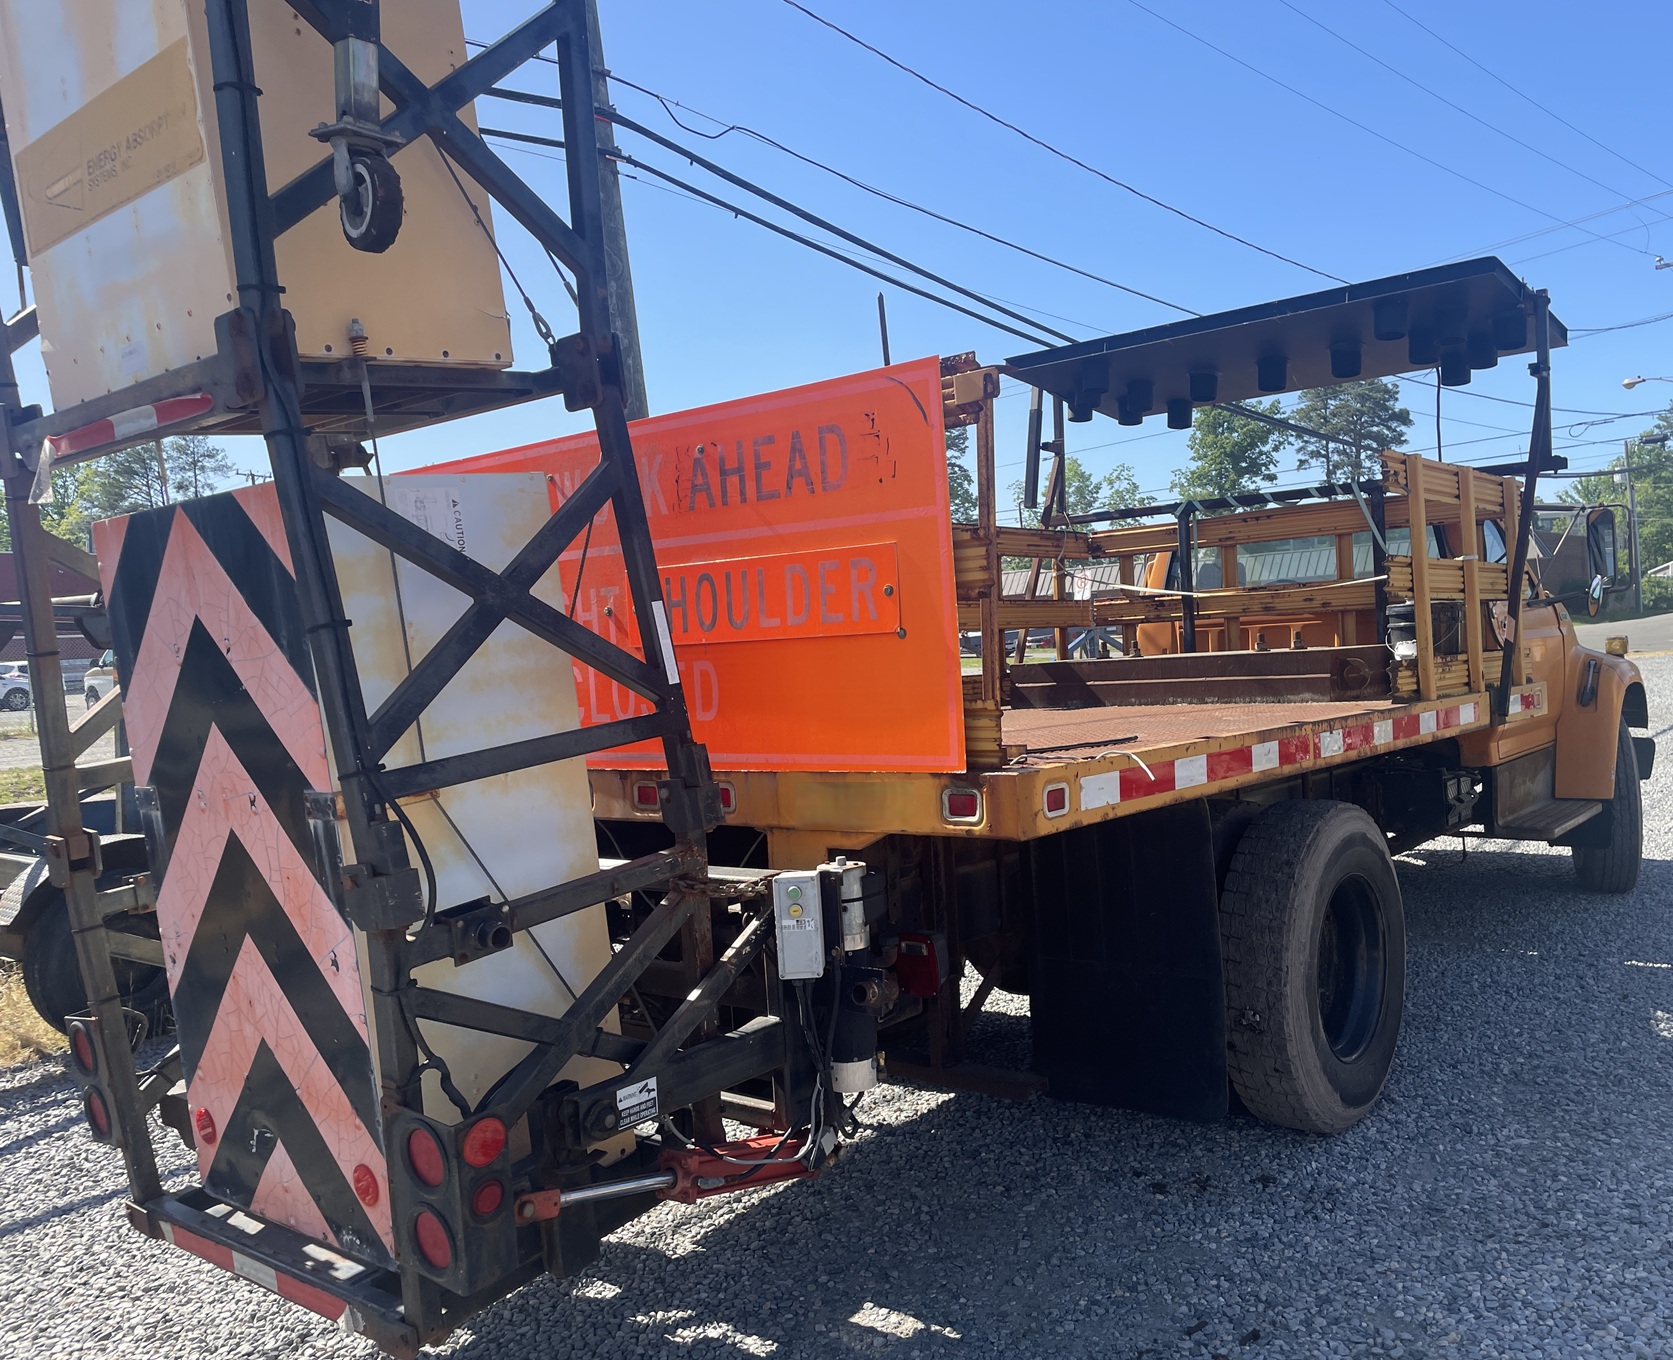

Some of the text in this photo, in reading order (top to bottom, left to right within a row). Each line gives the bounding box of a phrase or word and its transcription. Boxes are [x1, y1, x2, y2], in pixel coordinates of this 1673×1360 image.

[86, 141, 122, 176] ENERGY
[87, 164, 118, 191] SYSTEMS
[554, 423, 848, 525] WK AHEAD
[453, 510, 467, 553] CAUTION
[664, 557, 878, 634] HOULDER
[573, 660, 719, 722] LOD
